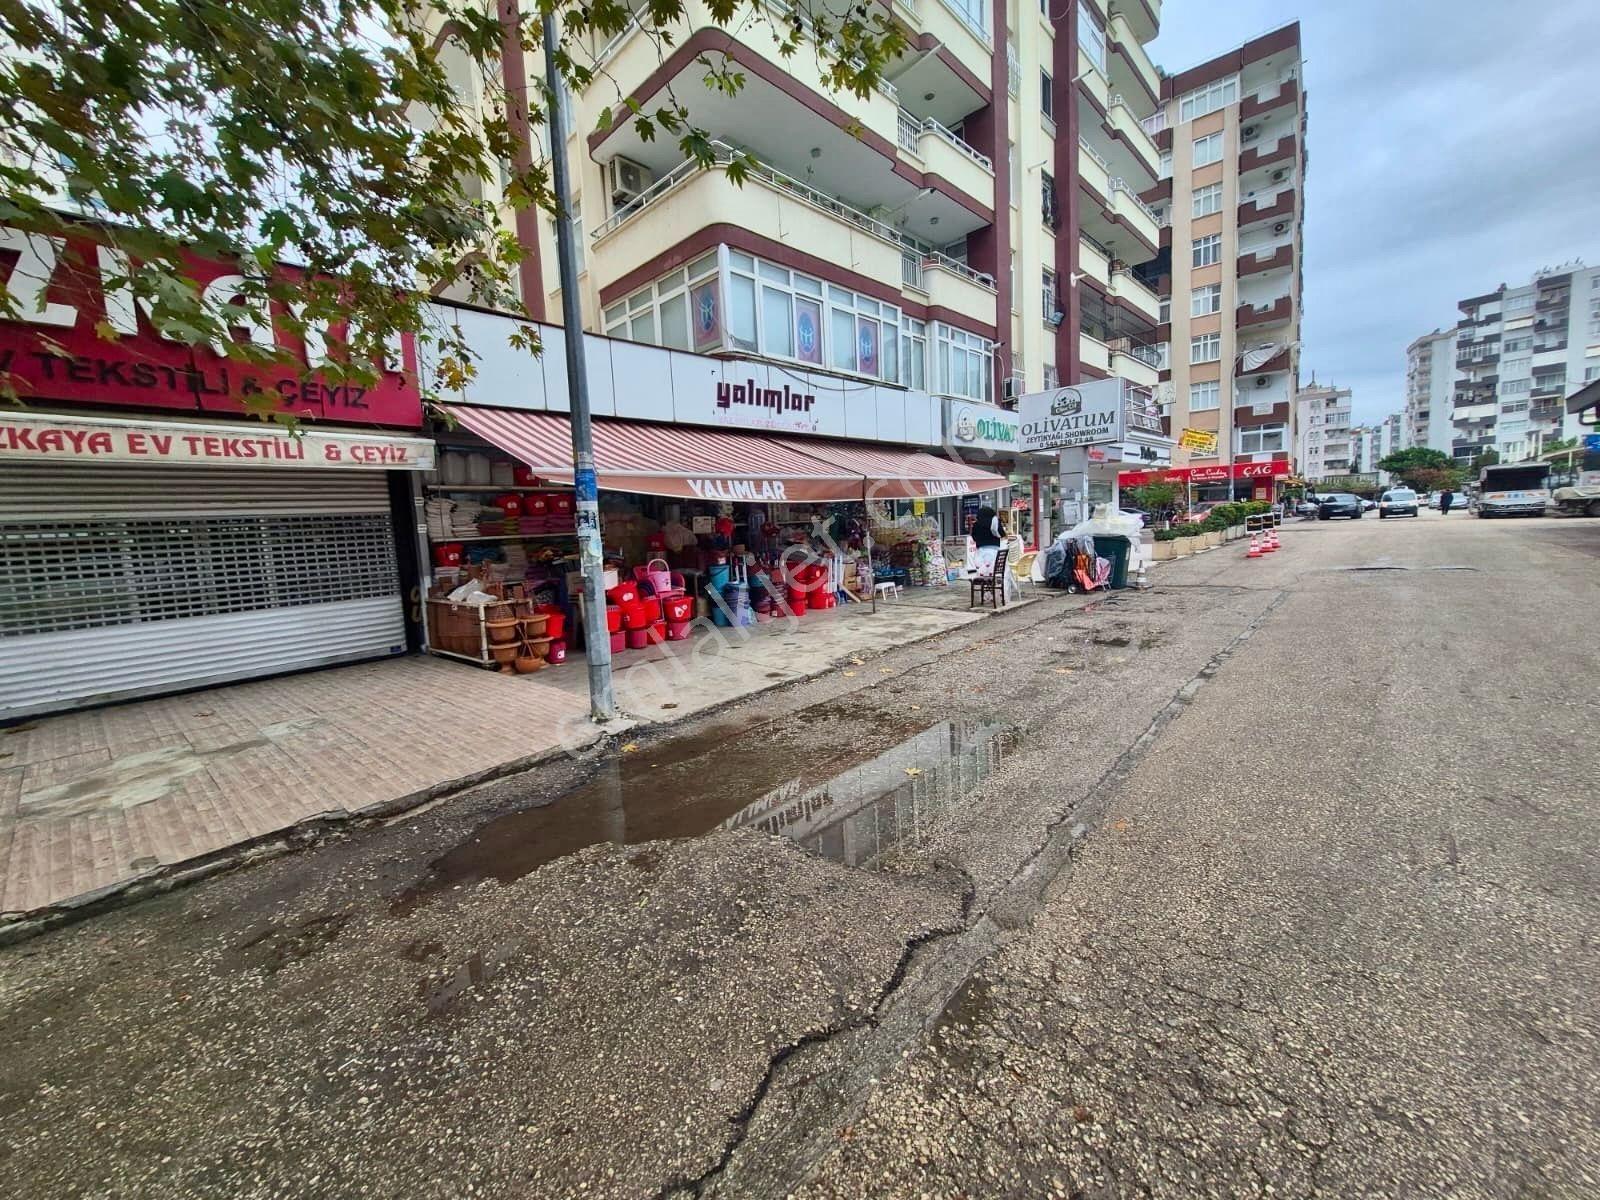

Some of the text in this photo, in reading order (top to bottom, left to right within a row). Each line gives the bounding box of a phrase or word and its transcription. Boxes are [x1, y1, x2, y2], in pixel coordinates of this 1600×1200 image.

[1021, 410, 1115, 436] OLİVATUM
[1064, 426, 1109, 439] SHOWROOM
[126, 433, 173, 455] EV
[325, 443, 342, 461] &
[350, 443, 409, 466] ÇEYİZ
[1243, 463, 1273, 478] ÇAĞ
[687, 479, 787, 500] YALIMLAR
[924, 481, 971, 496] YALIMLAR
